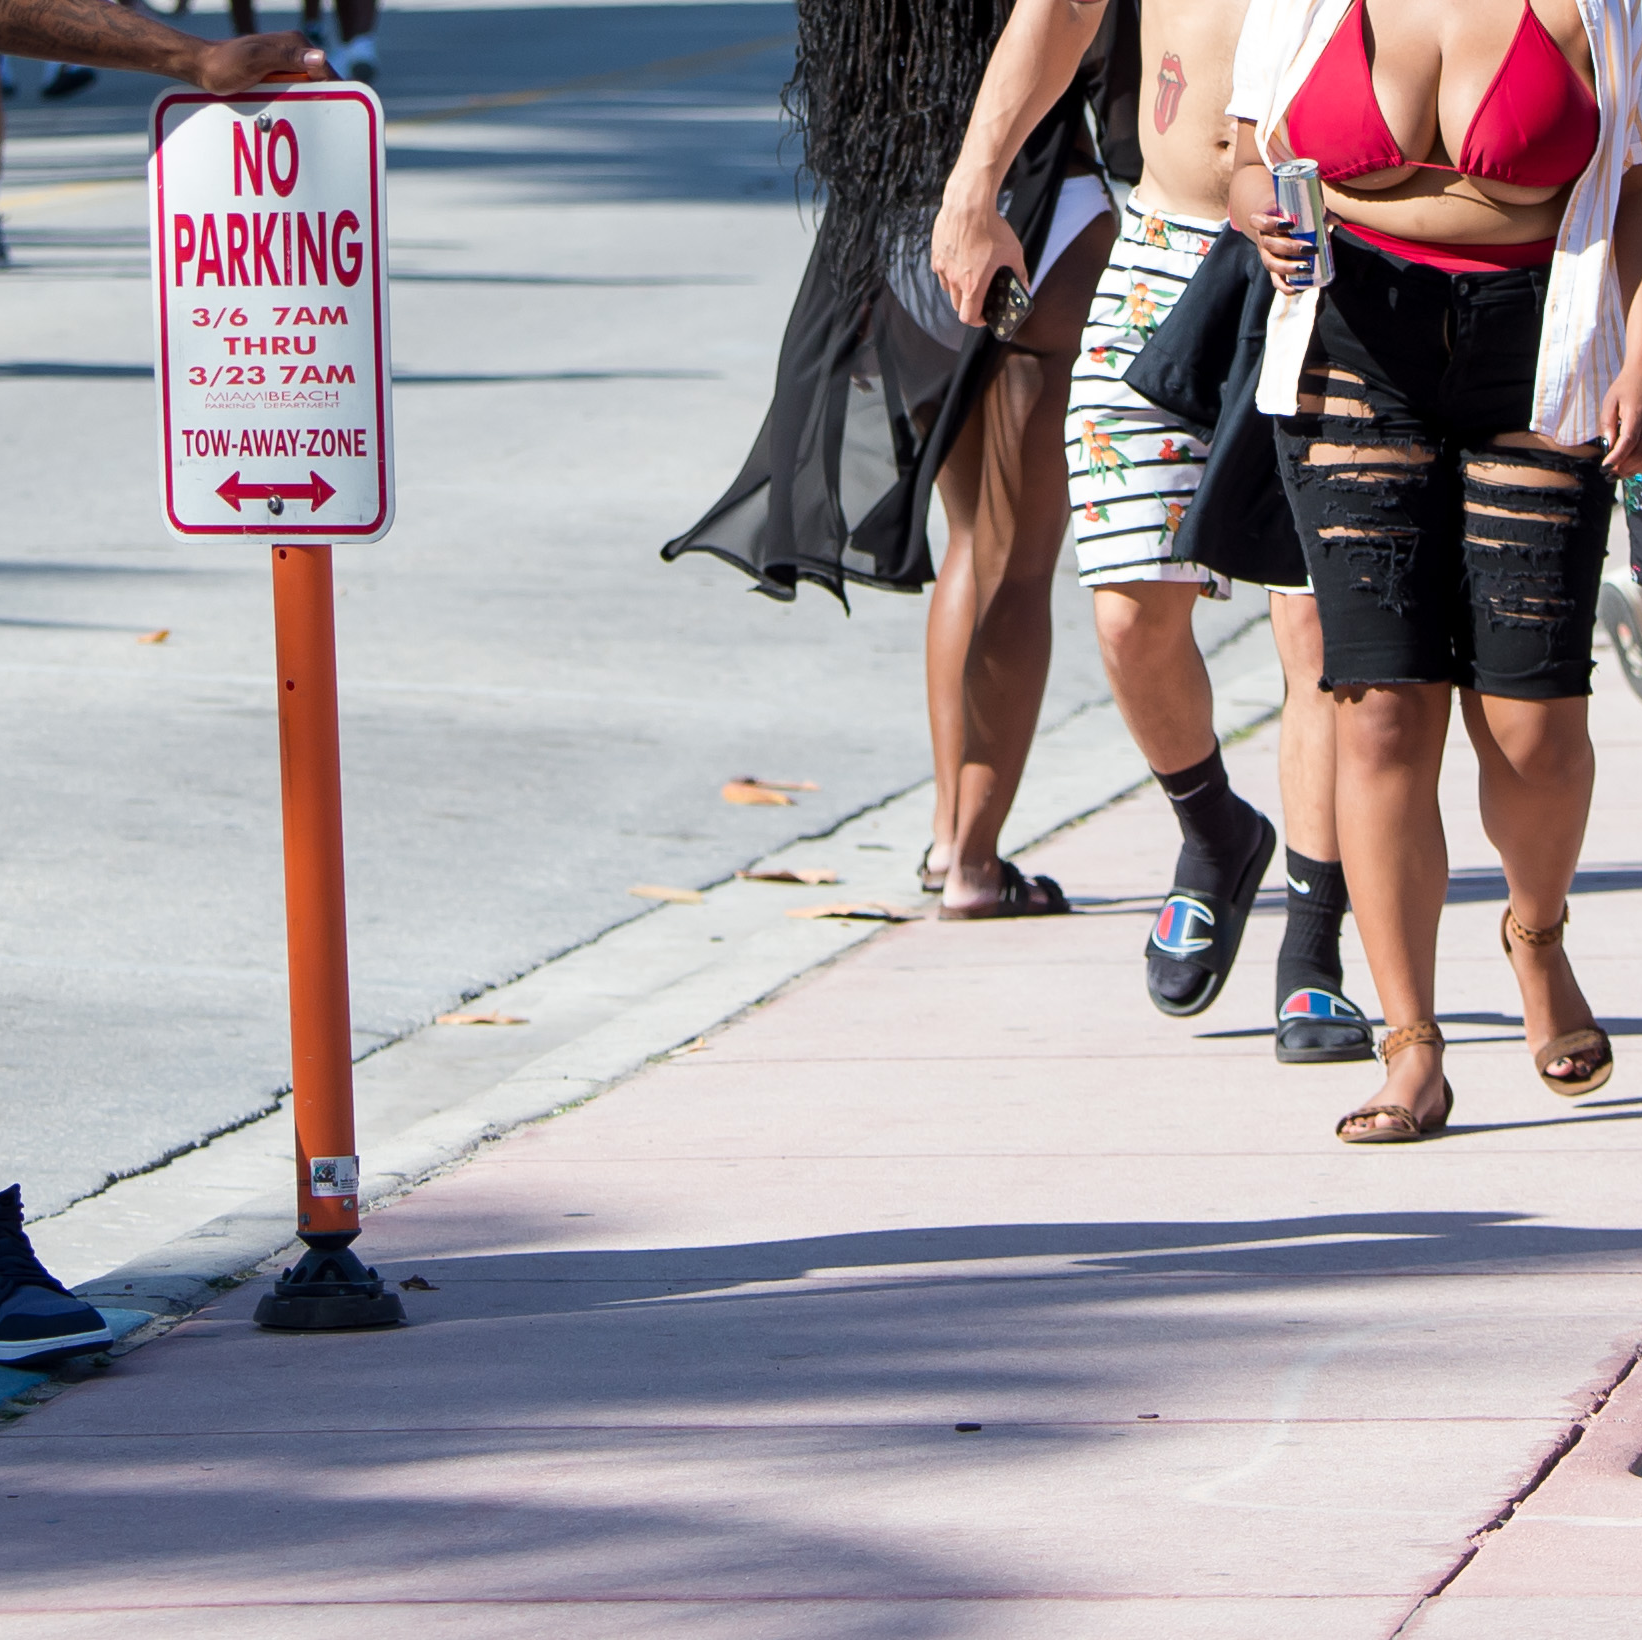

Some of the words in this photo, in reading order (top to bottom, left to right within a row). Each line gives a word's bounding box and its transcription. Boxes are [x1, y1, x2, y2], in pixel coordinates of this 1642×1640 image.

[233, 118, 299, 198] NO
[174, 209, 364, 288] PARKING
[191, 306, 249, 329] 3/6
[273, 305, 349, 327] 7AM
[223, 336, 317, 356] THRU
[188, 365, 266, 388] 3/23
[279, 364, 356, 385] 7AM
[263, 401, 341, 409] DEPARTMENT
[181, 428, 368, 458] TOW-AWAY-ZONE
